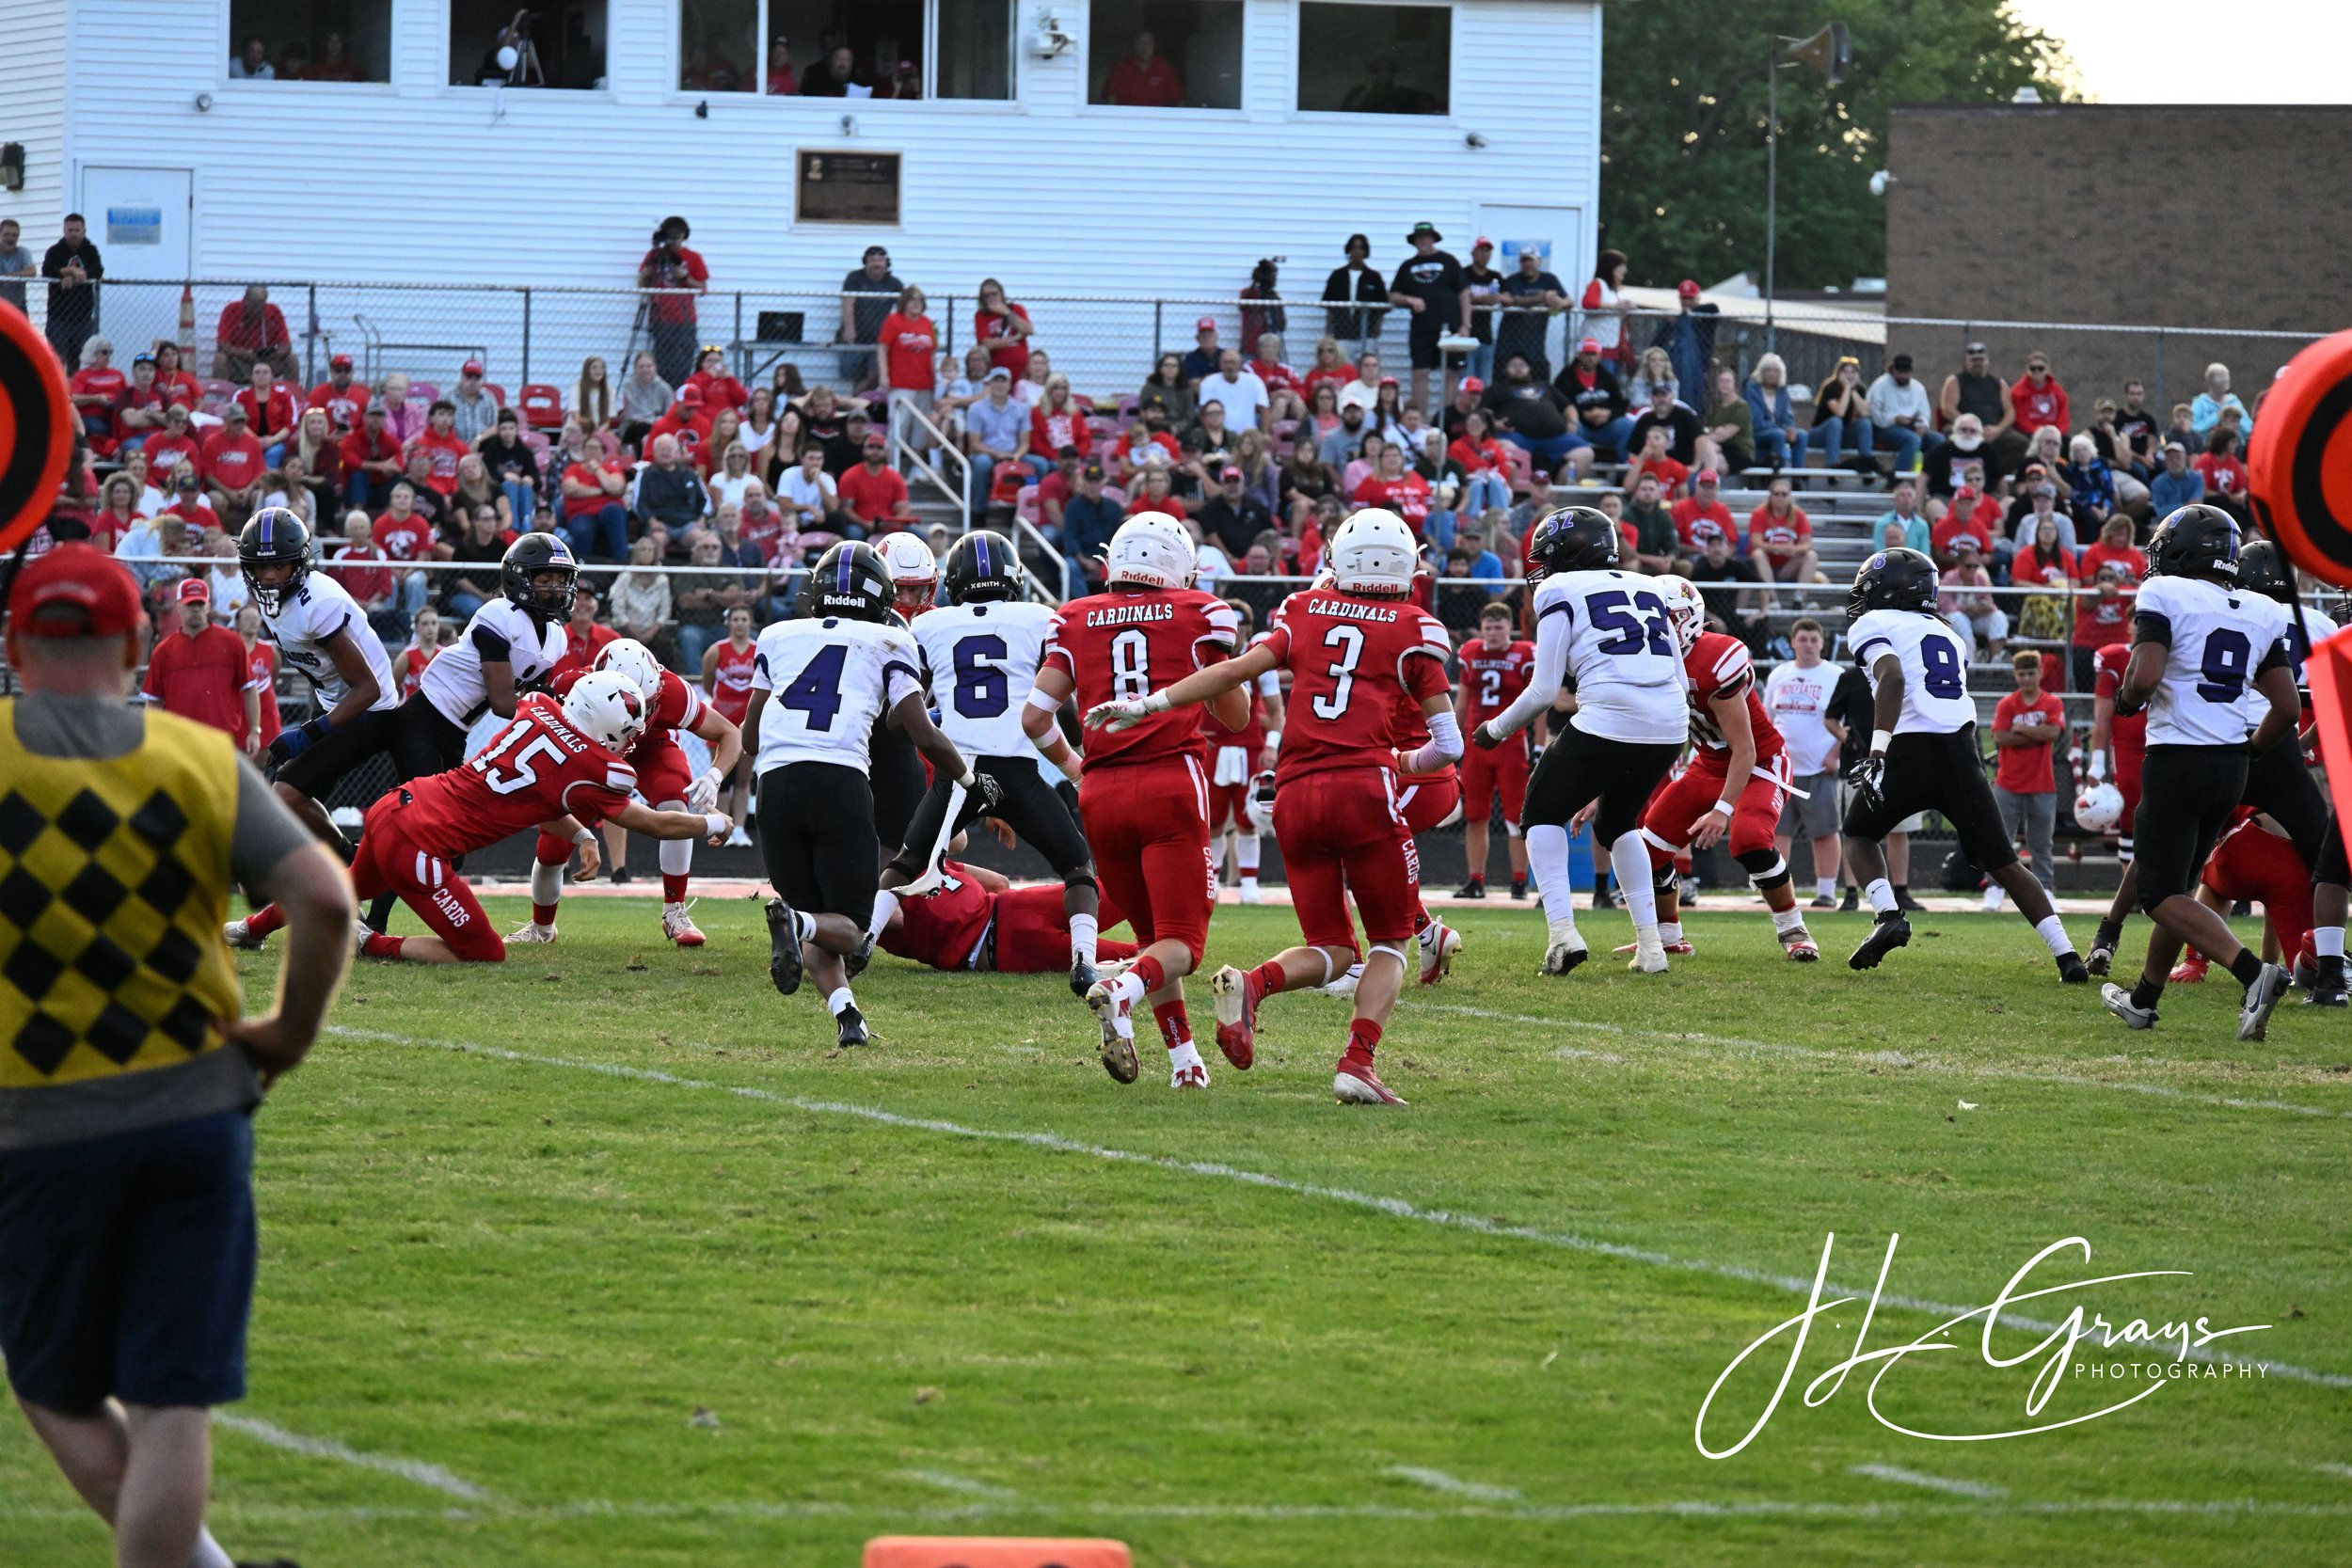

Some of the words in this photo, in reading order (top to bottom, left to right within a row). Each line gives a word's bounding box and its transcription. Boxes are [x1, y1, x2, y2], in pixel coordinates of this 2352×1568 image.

[1546, 511, 1574, 536] 52
[1121, 570, 1165, 586] Riddell
[1873, 553, 1887, 570] 8
[297, 587, 311, 608] 2
[823, 594, 866, 609] Riddell
[970, 581, 999, 590] XENITH
[1352, 582, 1399, 594] Riddell
[1087, 603, 1173, 628] CARDINALS
[1308, 598, 1398, 624] CARDINALS
[1584, 590, 1673, 657] 52
[952, 633, 1009, 720] 6
[1111, 628, 1152, 703] 8
[1311, 623, 1365, 721] 3
[1920, 633, 1963, 701] 8
[2197, 626, 2251, 704] 9
[778, 644, 849, 733] 4
[1481, 669, 1501, 706] 2
[529, 705, 589, 753] CARDINALS
[470, 718, 568, 797] 15
[1202, 847, 1215, 900] CARDS
[1402, 838, 1421, 885] CARDS
[431, 887, 470, 928] CARDS
